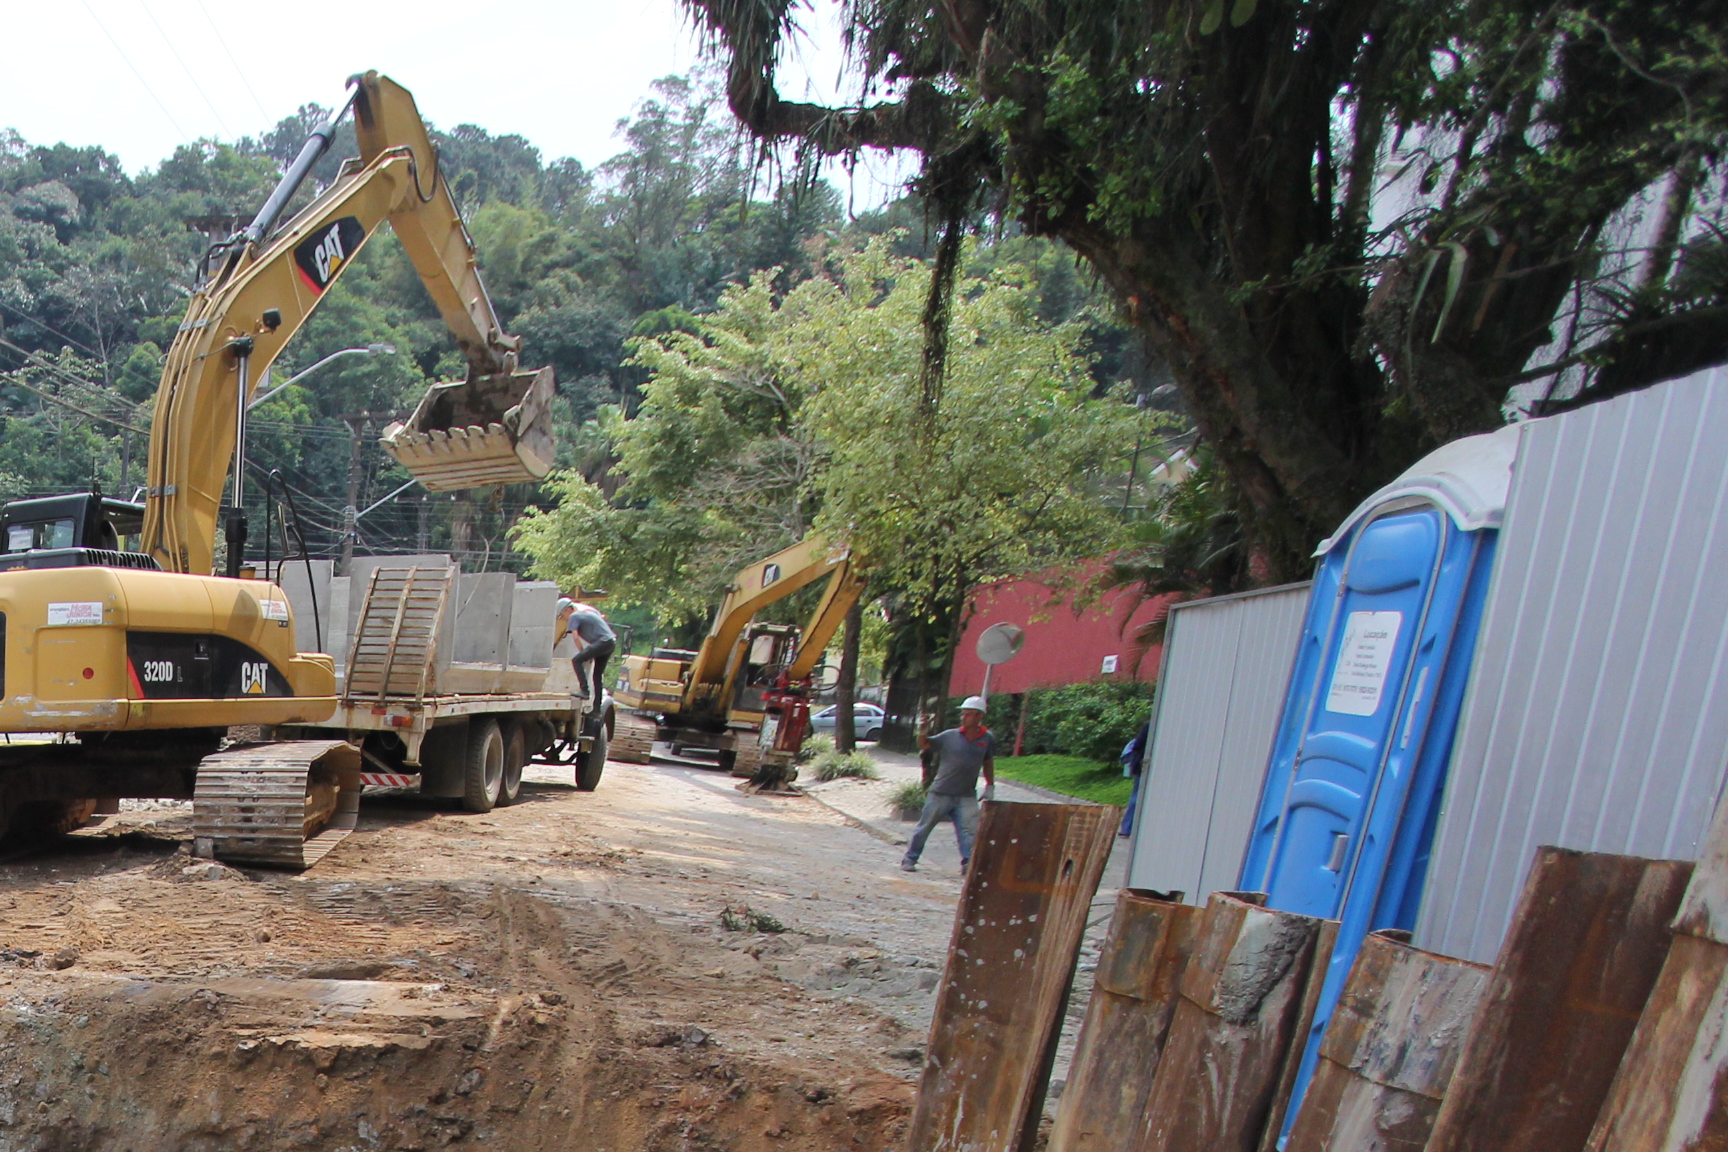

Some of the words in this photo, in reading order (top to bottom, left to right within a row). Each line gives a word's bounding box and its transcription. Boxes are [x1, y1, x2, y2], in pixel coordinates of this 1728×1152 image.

[315, 222, 345, 283] CAT
[144, 661, 173, 682] 320D
[241, 661, 269, 694] CAT
